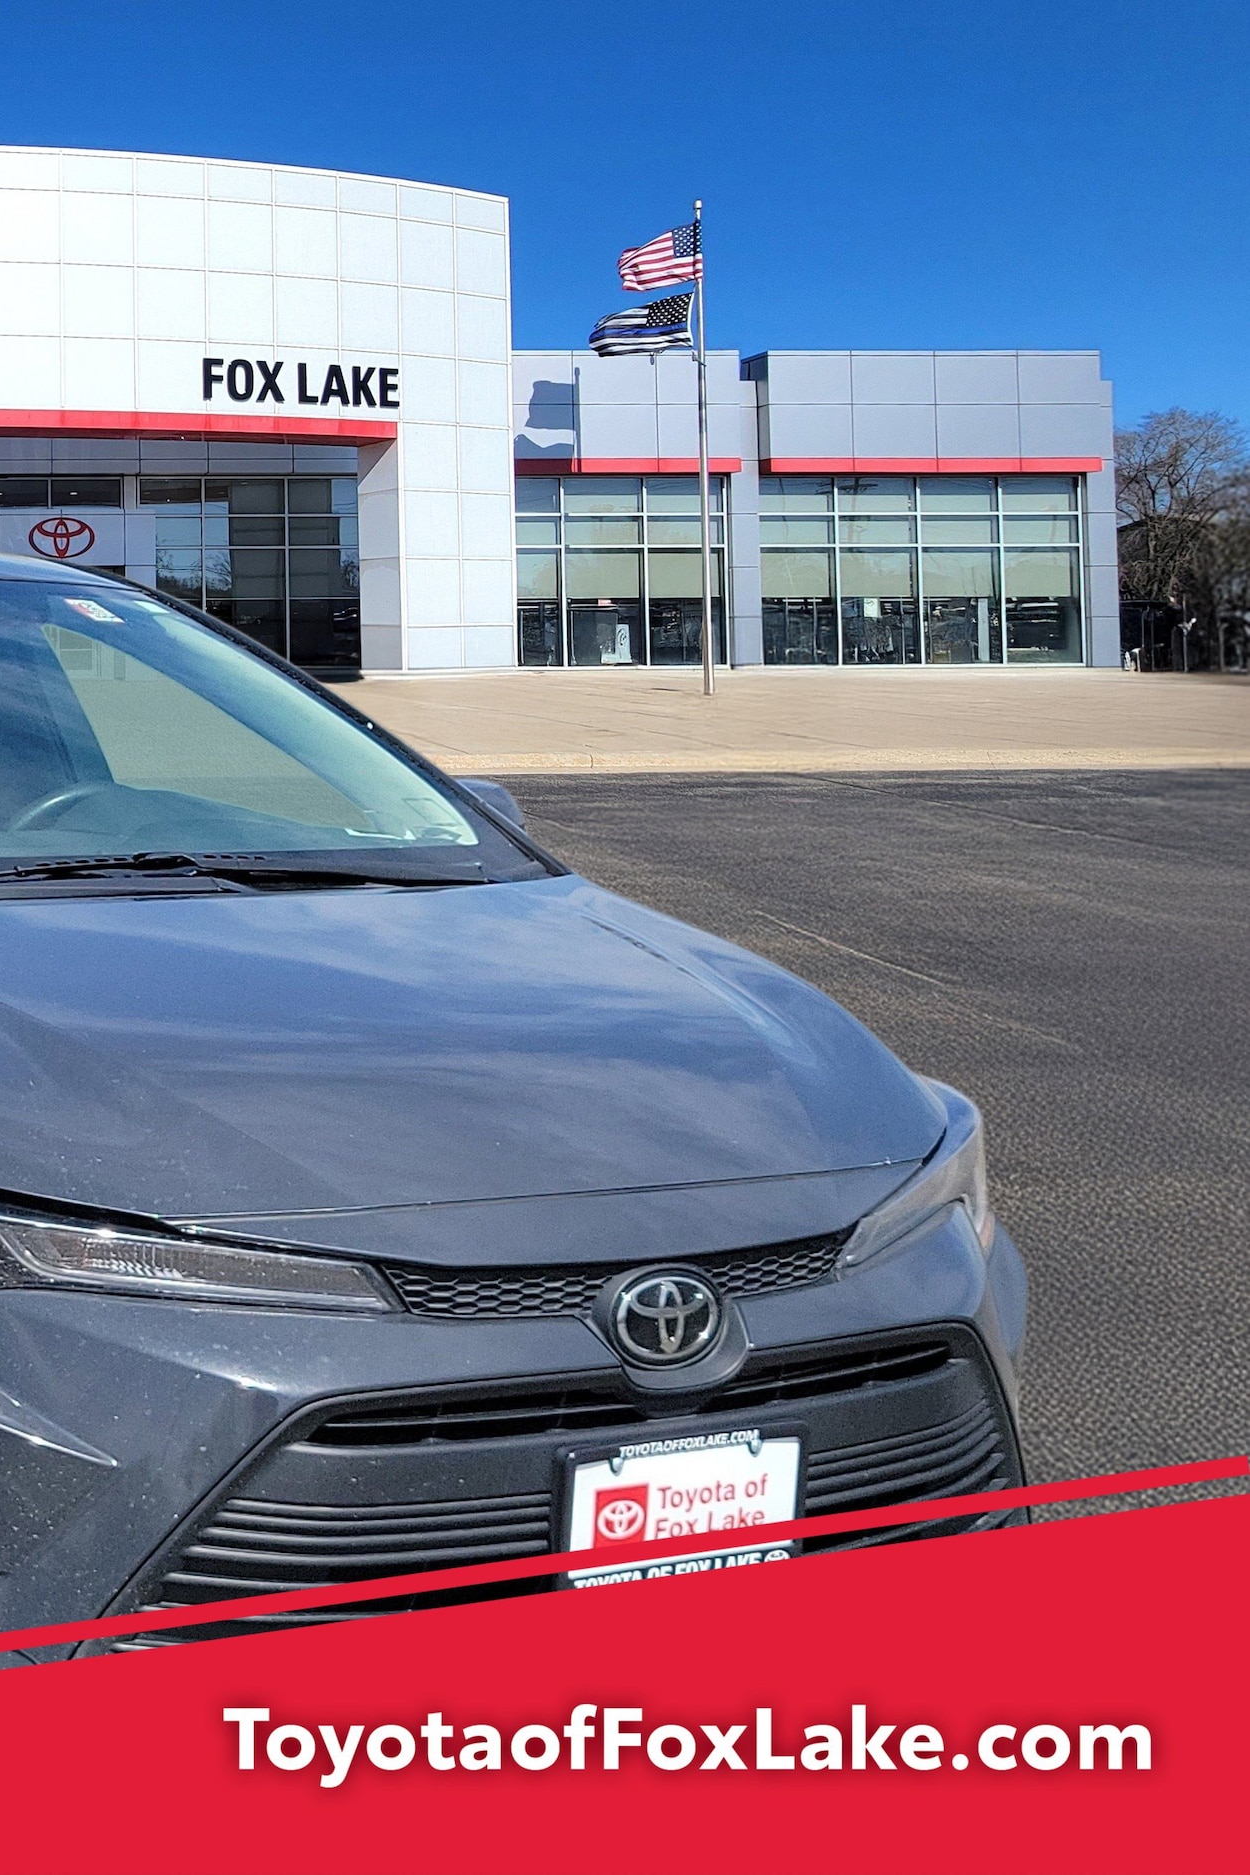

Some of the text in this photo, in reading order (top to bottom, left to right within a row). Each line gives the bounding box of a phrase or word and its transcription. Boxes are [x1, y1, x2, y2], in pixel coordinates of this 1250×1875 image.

[202, 357, 400, 408] FOX LAKE
[618, 1428, 759, 1458] TOYOTAOFFOXLAKE.COM
[656, 1472, 769, 1513] Toyota of
[653, 1506, 766, 1541] Fox Lake
